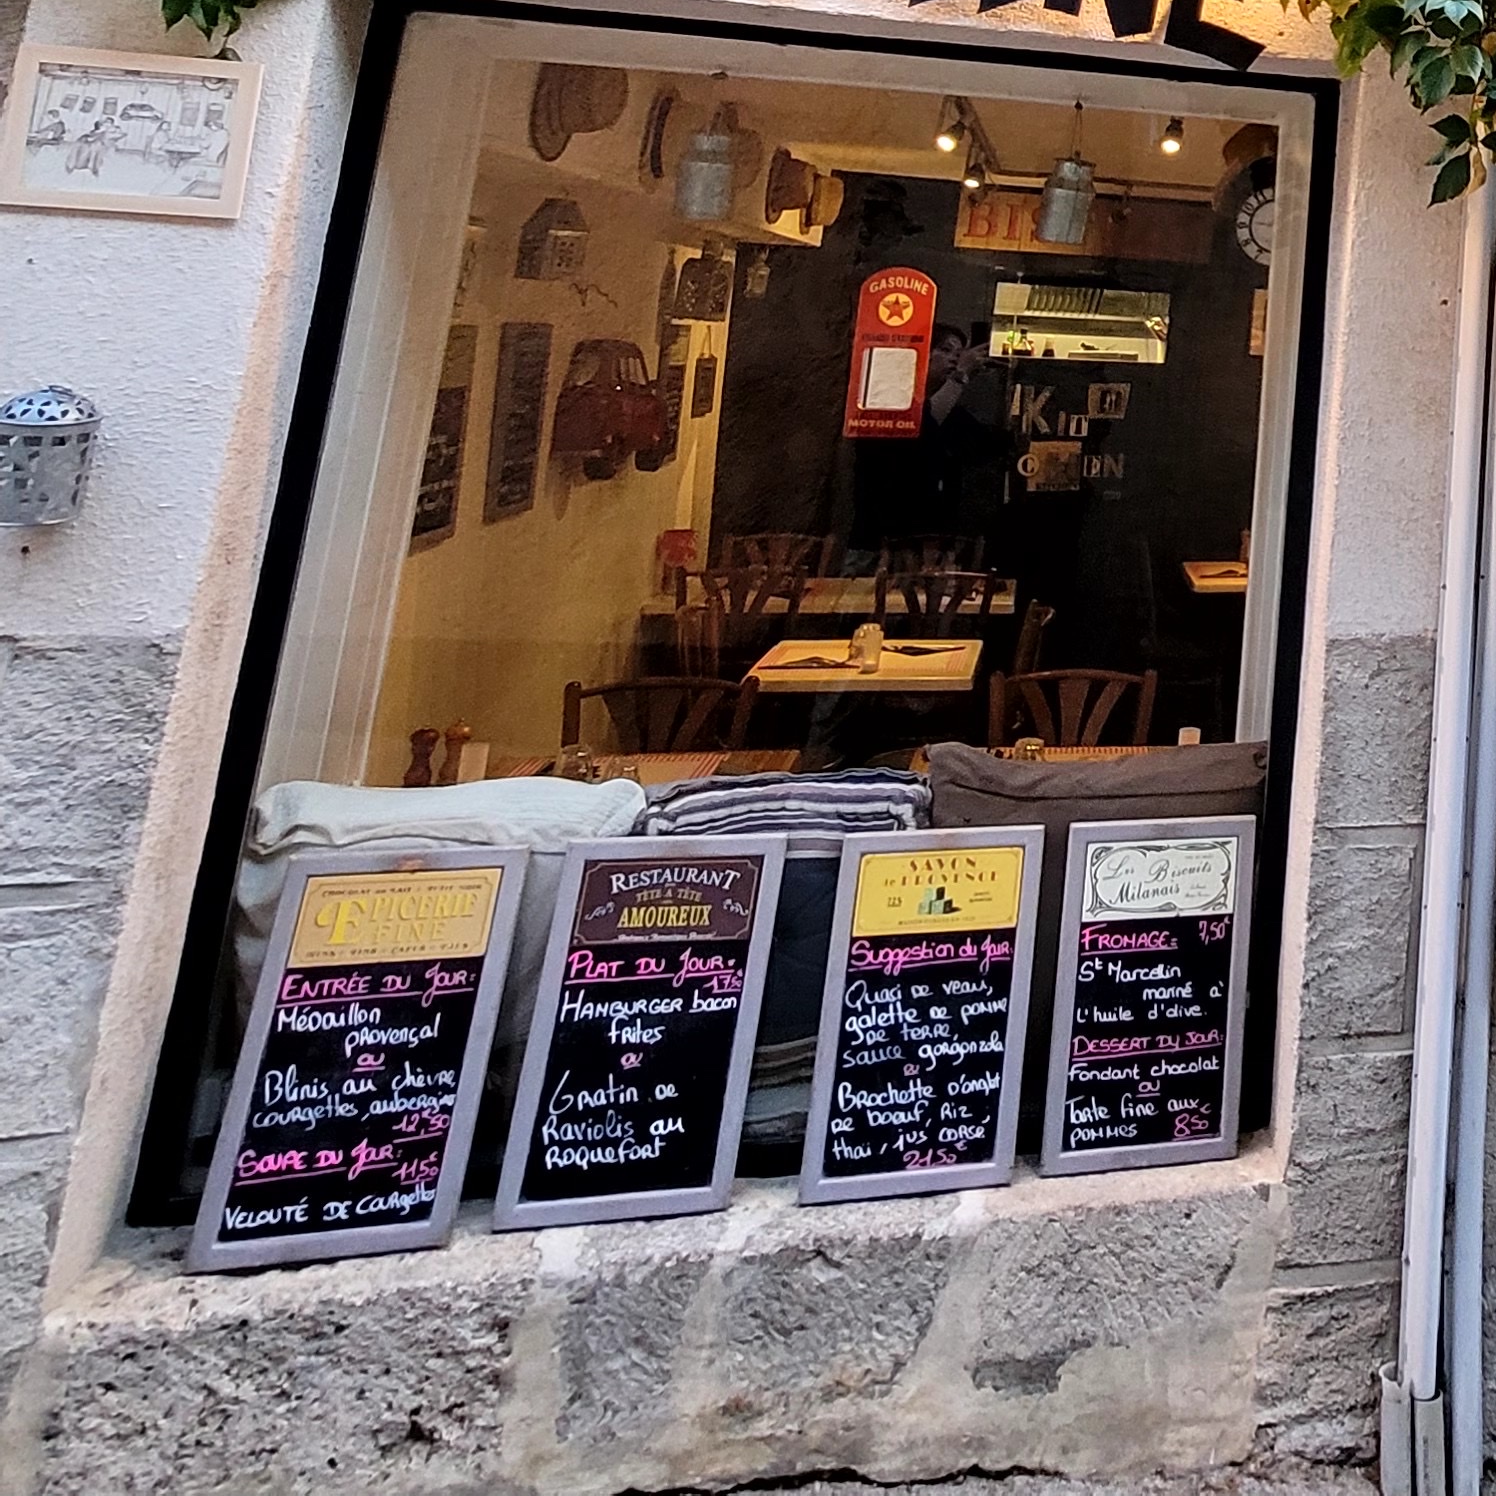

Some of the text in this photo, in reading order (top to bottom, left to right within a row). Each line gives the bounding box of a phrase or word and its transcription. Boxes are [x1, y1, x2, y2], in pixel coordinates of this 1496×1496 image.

[869, 276, 930, 295] GASOLINE
[848, 418, 916, 429] MOTOR OIL
[909, 856, 978, 873] SAVON
[1144, 858, 1213, 884] Biscuits
[609, 867, 742, 895] RESTAURANT
[901, 870, 998, 886] PROVENCE
[1109, 879, 1181, 905] Milanais
[616, 905, 713, 929] AMOUREUX
[373, 920, 448, 945] FINE
[568, 950, 626, 979] PLAT
[635, 957, 666, 975] DU
[850, 940, 955, 976] Suggestion
[958, 937, 978, 957] du
[1078, 957, 1103, 982] St
[281, 971, 373, 1001] ENTRÉE
[380, 973, 411, 992] DU
[845, 979, 902, 1012] Quasi
[560, 988, 737, 1023] HAMBURGER bacon
[845, 1001, 922, 1046] galette
[842, 1045, 907, 1069] sauce
[1072, 1034, 1152, 1056] DESSERT
[1155, 1034, 1181, 1051] DU
[1150, 1055, 1220, 1077] chocolat
[264, 1064, 330, 1105] Blinis
[341, 1078, 377, 1096] au
[548, 1069, 640, 1115] Gratin
[837, 1077, 937, 1113] Brochette
[1065, 1092, 1200, 1124] Tarte fine aux
[649, 1116, 686, 1136] au
[892, 1129, 929, 1152] jus
[238, 1149, 308, 1178] SOUPE
[312, 1149, 344, 1169] DU
[225, 1196, 309, 1231] VELOUTÉ
[322, 1200, 352, 1221] DE
